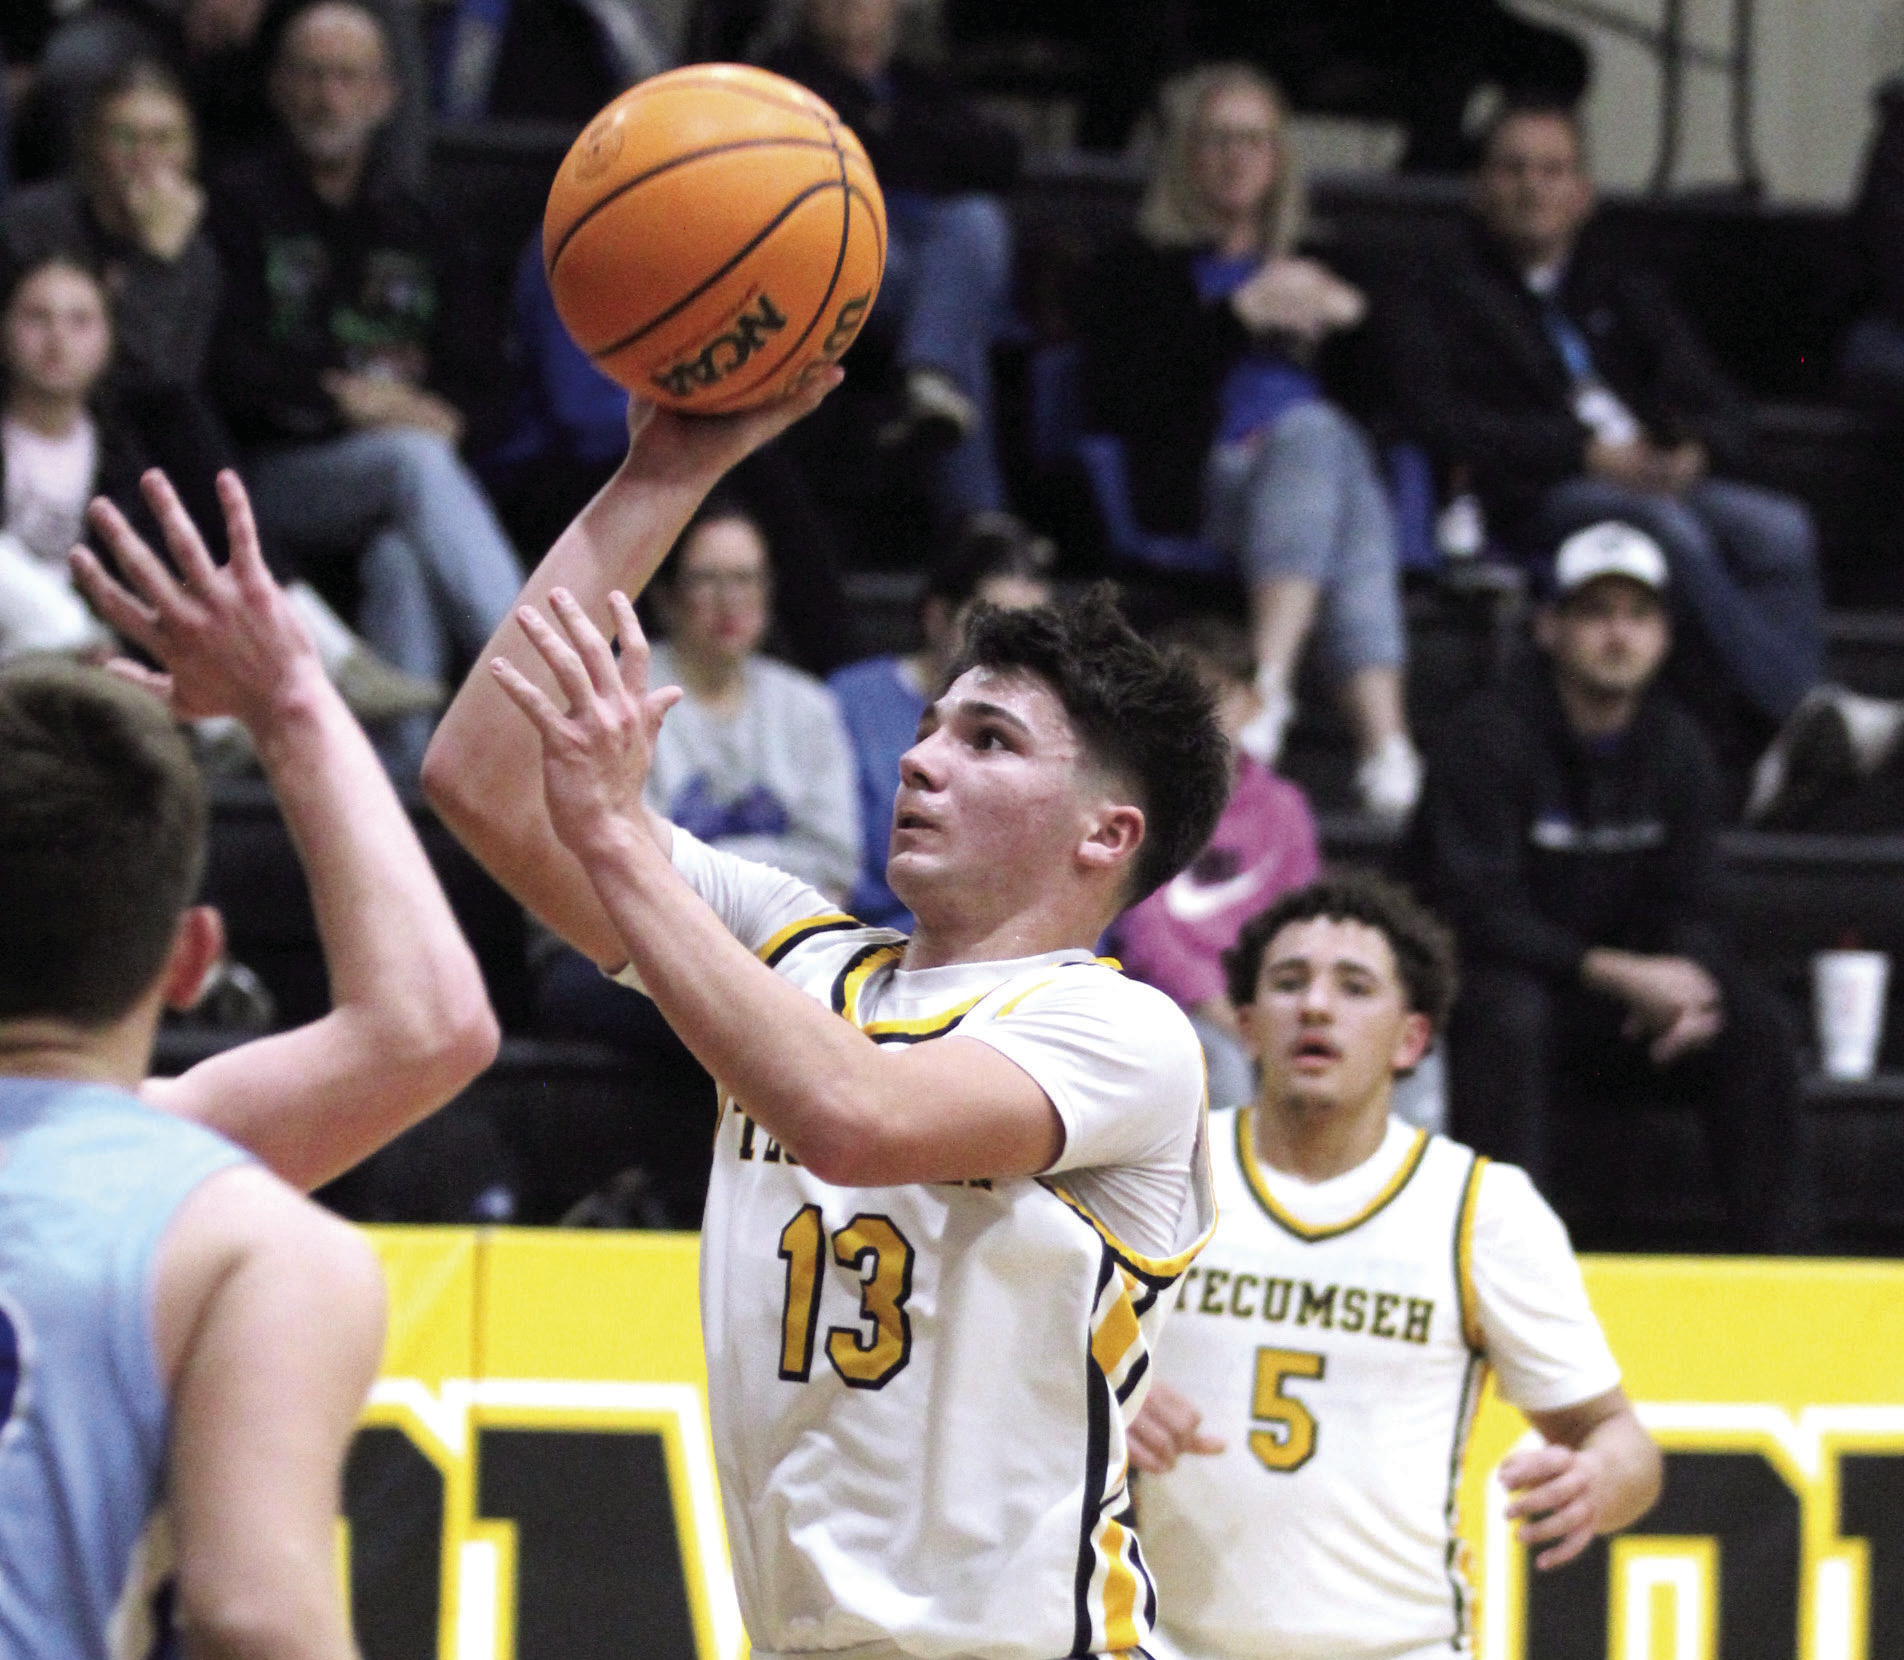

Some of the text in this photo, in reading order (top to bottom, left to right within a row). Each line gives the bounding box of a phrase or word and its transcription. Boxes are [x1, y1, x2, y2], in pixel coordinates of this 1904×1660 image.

[652, 293, 788, 396] NCAA
[777, 1203, 915, 1390] 13
[1174, 1267, 1435, 1344] TECUMSEH
[1249, 1346, 1326, 1473] 5
